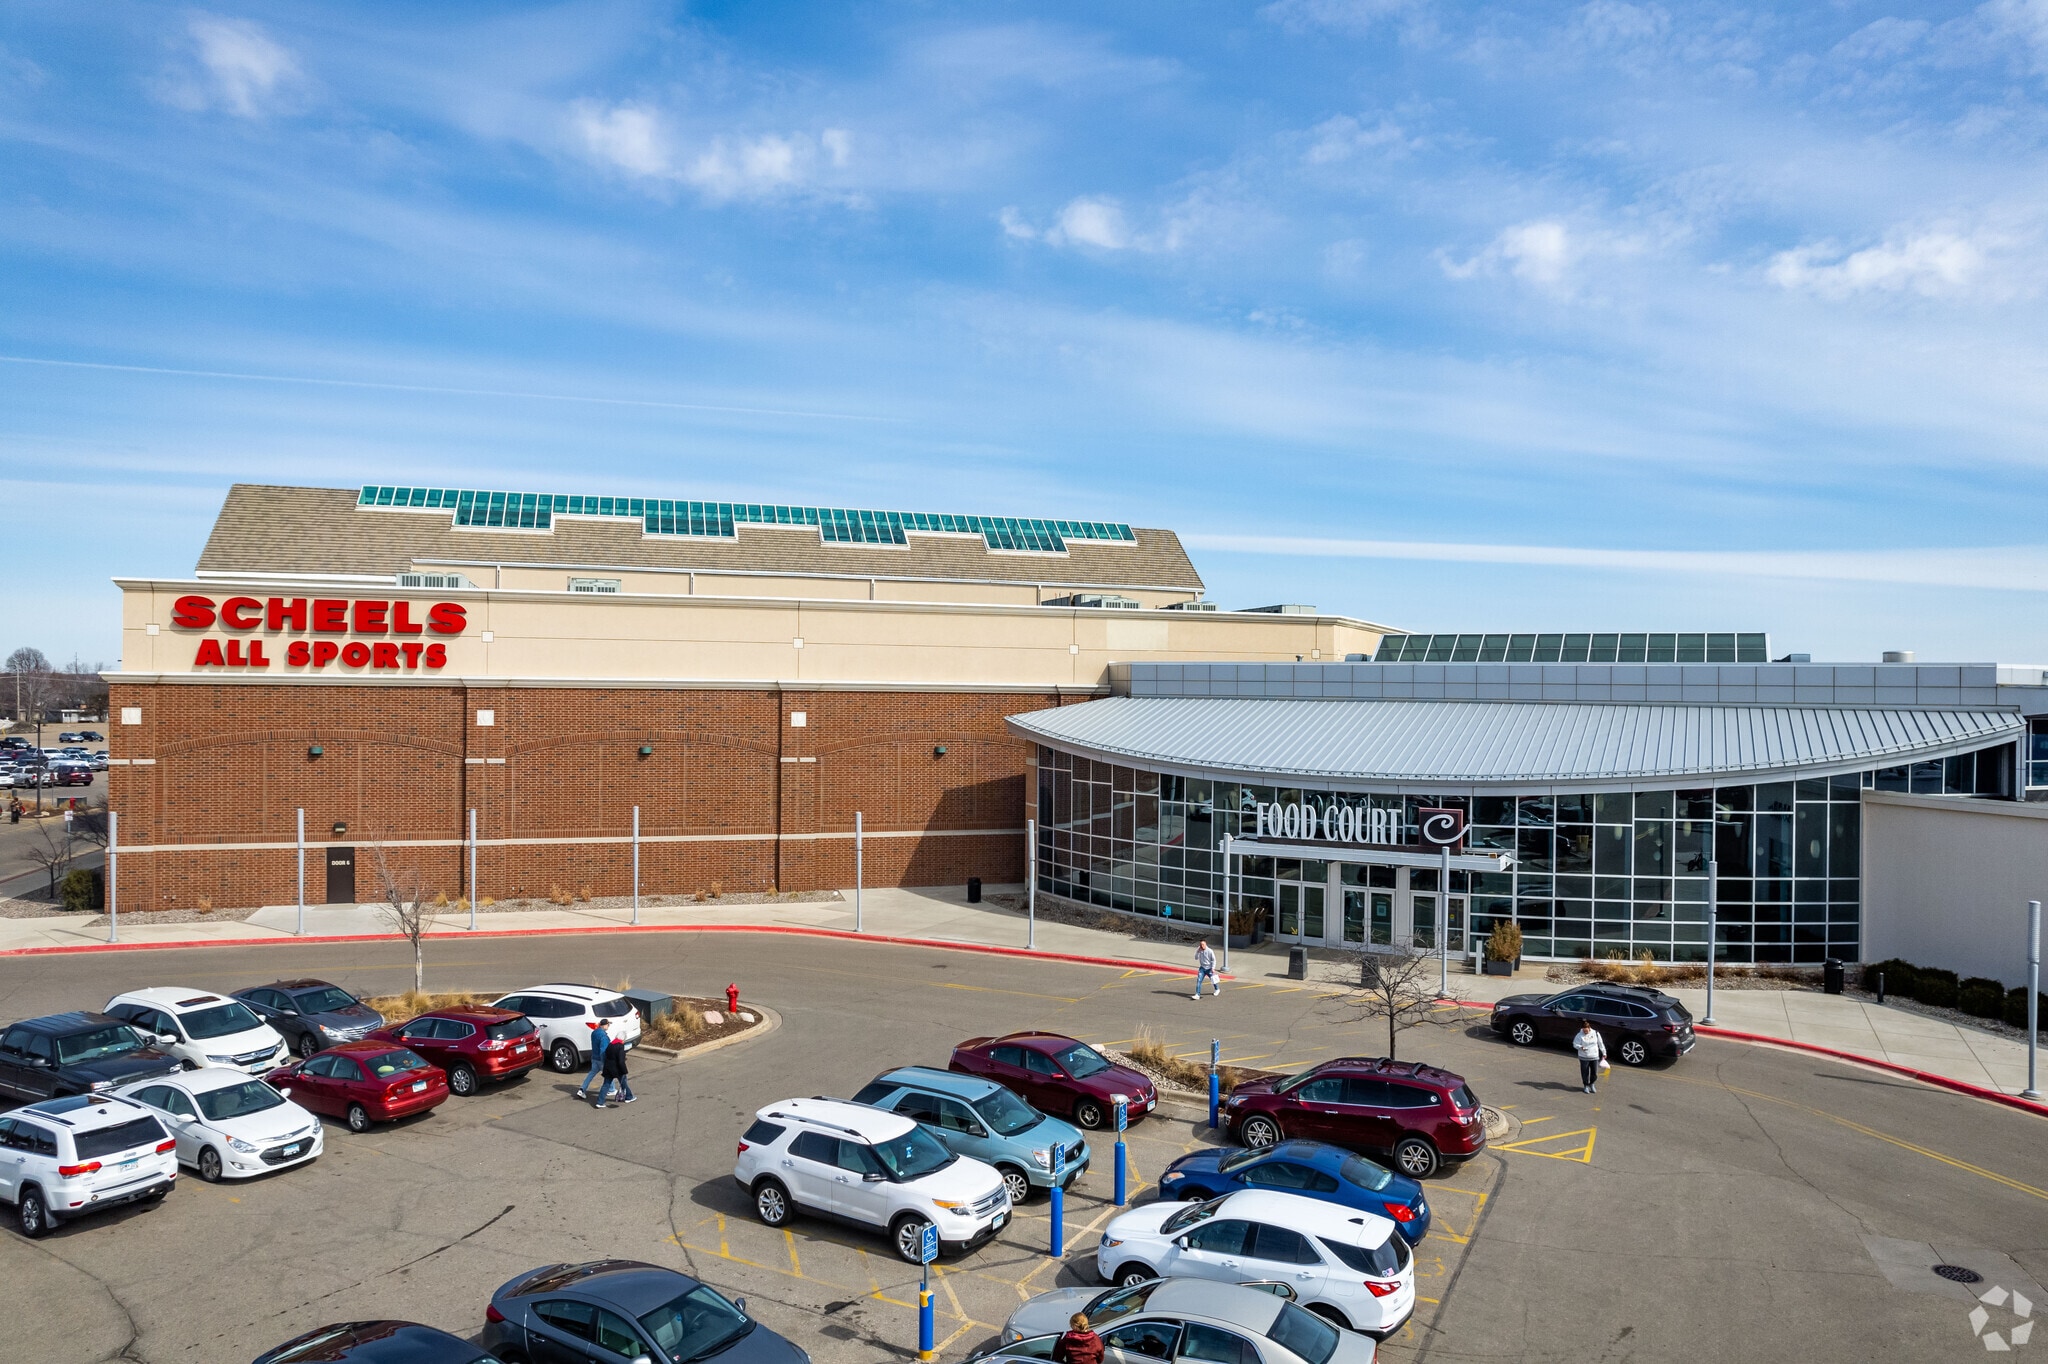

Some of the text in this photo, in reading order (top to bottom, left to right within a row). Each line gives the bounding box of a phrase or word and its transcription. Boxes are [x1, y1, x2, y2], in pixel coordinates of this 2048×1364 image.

[172, 595, 467, 635] SCHEELS
[194, 639, 447, 669] ALL SPORTS
[1257, 802, 1402, 846] FOOD COURT
